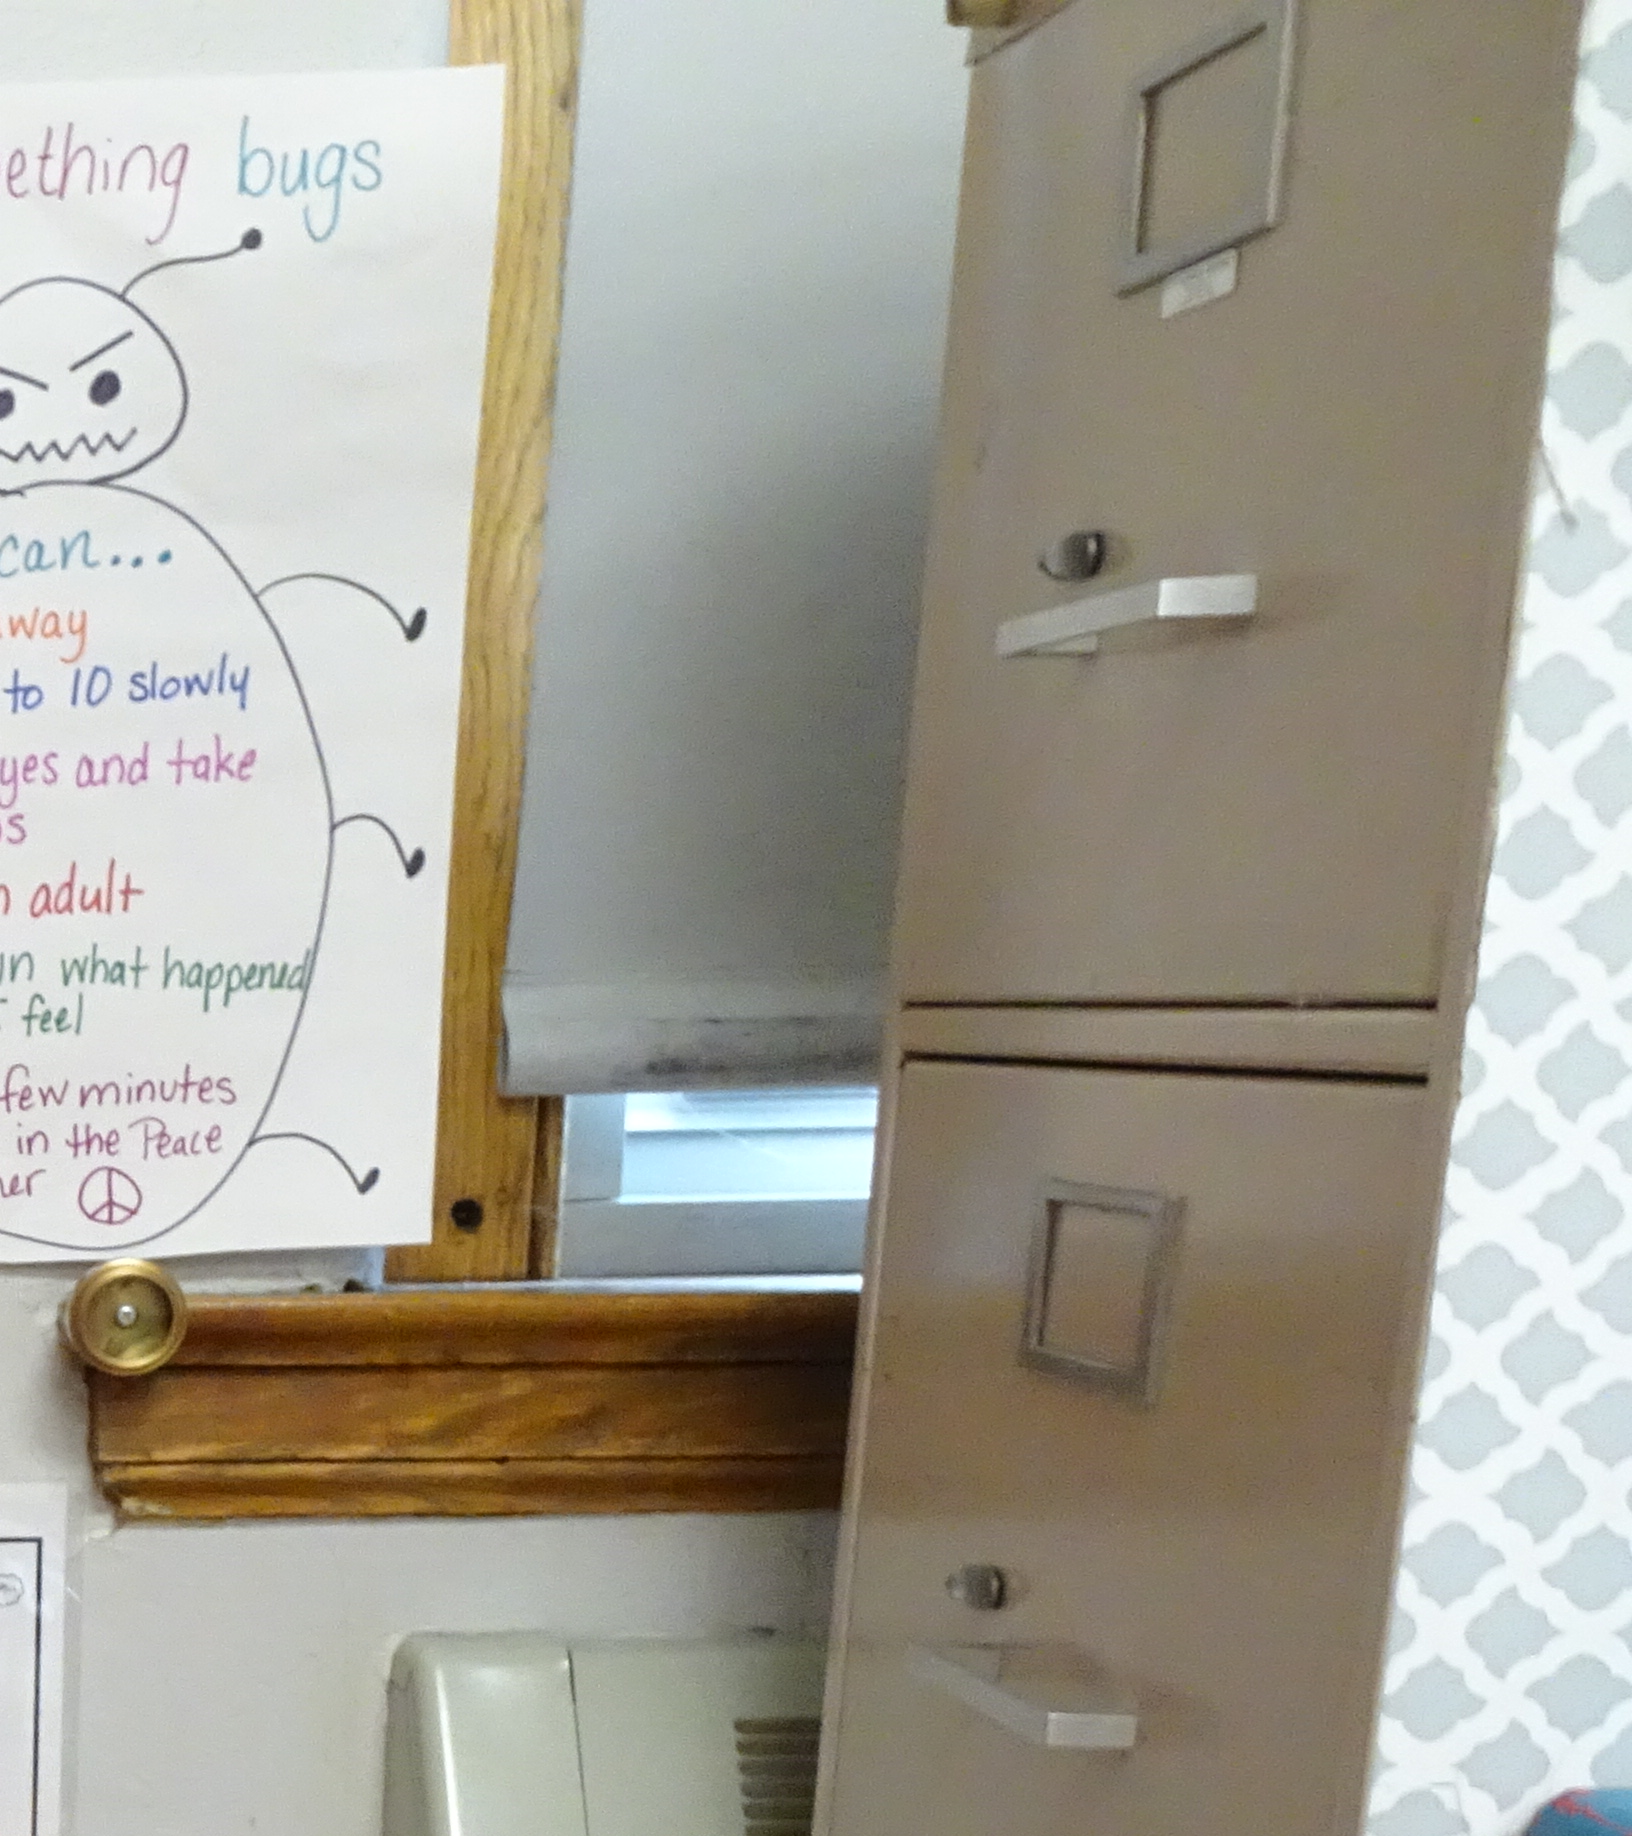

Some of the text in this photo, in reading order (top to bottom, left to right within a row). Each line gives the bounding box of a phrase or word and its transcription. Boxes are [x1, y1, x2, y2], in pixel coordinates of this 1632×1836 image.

[238, 114, 385, 243] bugs
[3, 669, 45, 716] to
[70, 665, 113, 708] 10
[127, 651, 252, 712] slowly
[75, 741, 150, 789] and
[167, 734, 259, 786] take
[28, 857, 147, 918] adult
[59, 942, 149, 988] what
[162, 946, 315, 1014] happened
[21, 991, 86, 1037] feel
[79, 1063, 238, 1107] minutes
[16, 1125, 50, 1157] in
[65, 1125, 122, 1158] the
[128, 1116, 224, 1159] Peace
